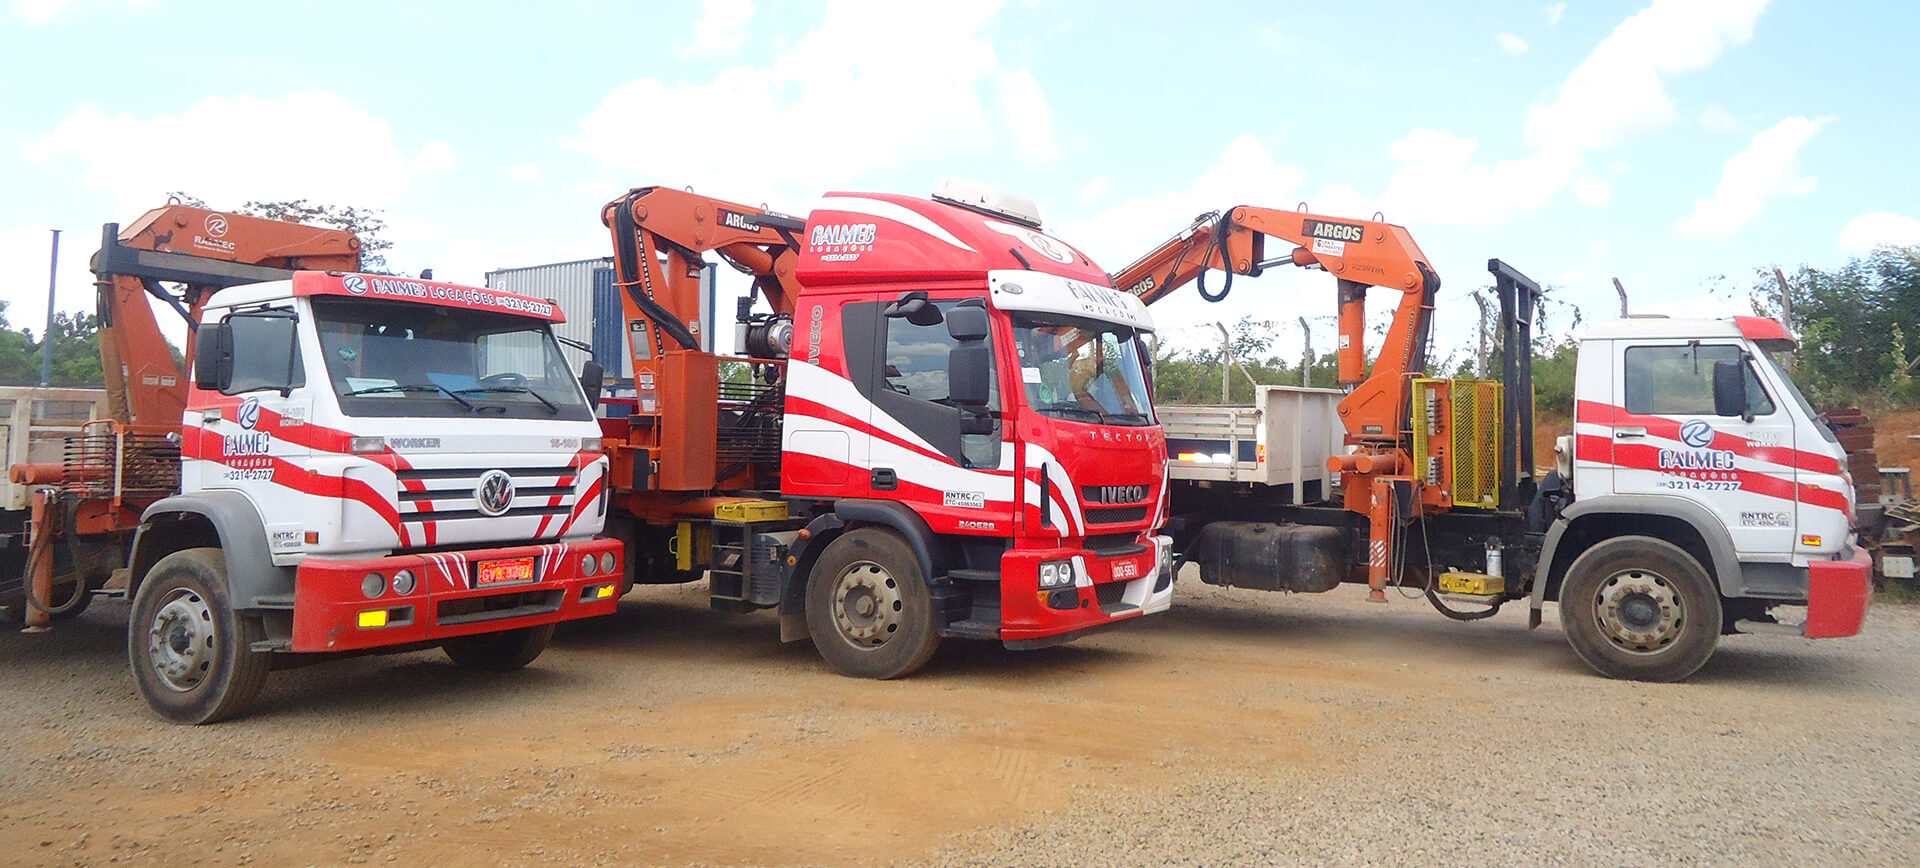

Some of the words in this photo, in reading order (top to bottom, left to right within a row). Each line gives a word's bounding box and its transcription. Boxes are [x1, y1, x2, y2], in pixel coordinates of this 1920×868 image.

[1314, 223, 1361, 241] ARGOS
[429, 285, 495, 306] LOCAÇÕES
[505, 297, 552, 316] 3214-2727
[808, 304, 824, 366] IVECO
[391, 438, 440, 448] WORKER
[229, 470, 274, 481] 3214-2727
[1668, 481, 1739, 491] 3214-2727
[945, 492, 971, 500] RNTRC
[1101, 485, 1143, 505] IVECO
[1741, 512, 1774, 520] RNTRC
